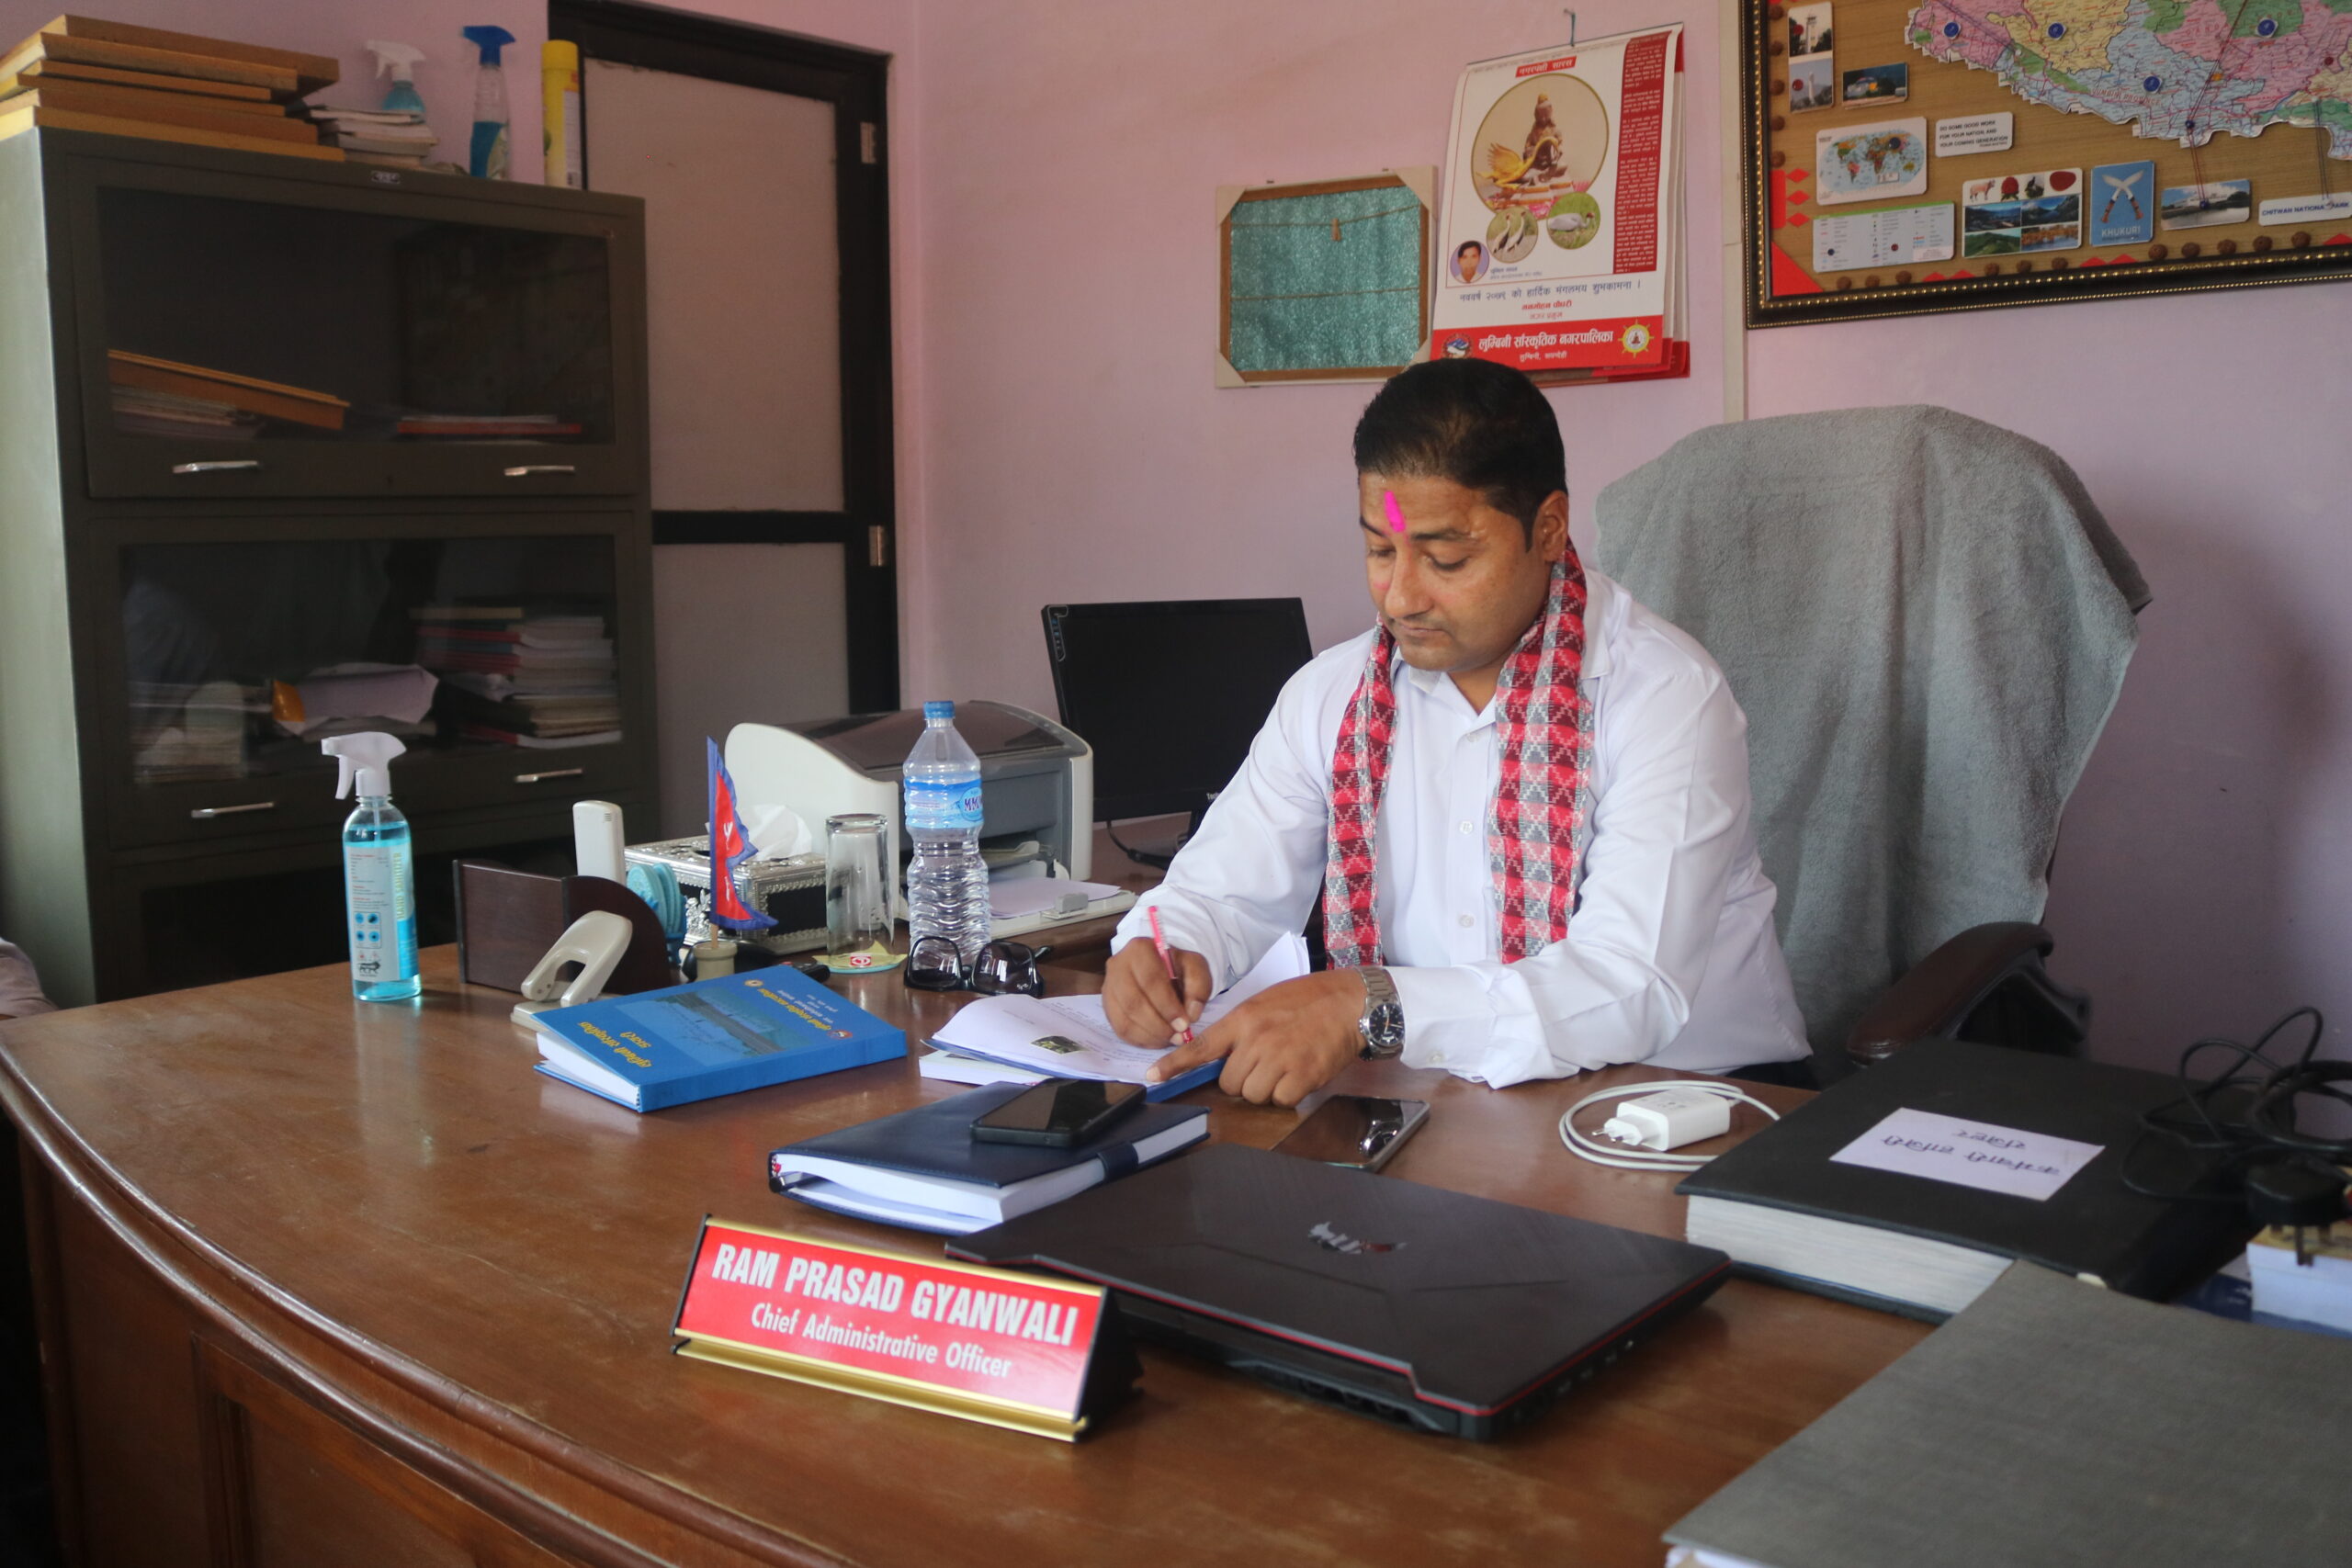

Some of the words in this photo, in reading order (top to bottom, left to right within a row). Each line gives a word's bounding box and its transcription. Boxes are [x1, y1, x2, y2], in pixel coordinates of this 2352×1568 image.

[2262, 208, 2293, 217] CHITWAN
[2294, 204, 2327, 213] NATIONA
[2101, 225, 2141, 238] KHUKURI
[1459, 290, 1482, 302] नववर्ष
[1511, 288, 1522, 299] को
[1526, 285, 1552, 299] हार्दिक
[1555, 282, 1588, 295] मंगलमय
[1592, 280, 1633, 295] शुभकामना
[1478, 334, 1511, 353] लुम्बिनी
[1513, 331, 1556, 349] सांस्कृतिक
[1559, 328, 1613, 345] नगरपालिका
[396, 897, 406, 920] HAND
[1880, 1134, 1955, 1155] हाजिरी
[1963, 1150, 2060, 1176] कर्मचारी
[712, 1243, 779, 1288] RAM
[784, 1256, 905, 1314] PRASAD
[910, 1278, 1080, 1347] GYANWALI
[752, 1302, 798, 1333] Chief
[802, 1314, 938, 1364] Administrative
[944, 1341, 1012, 1379] Officer
